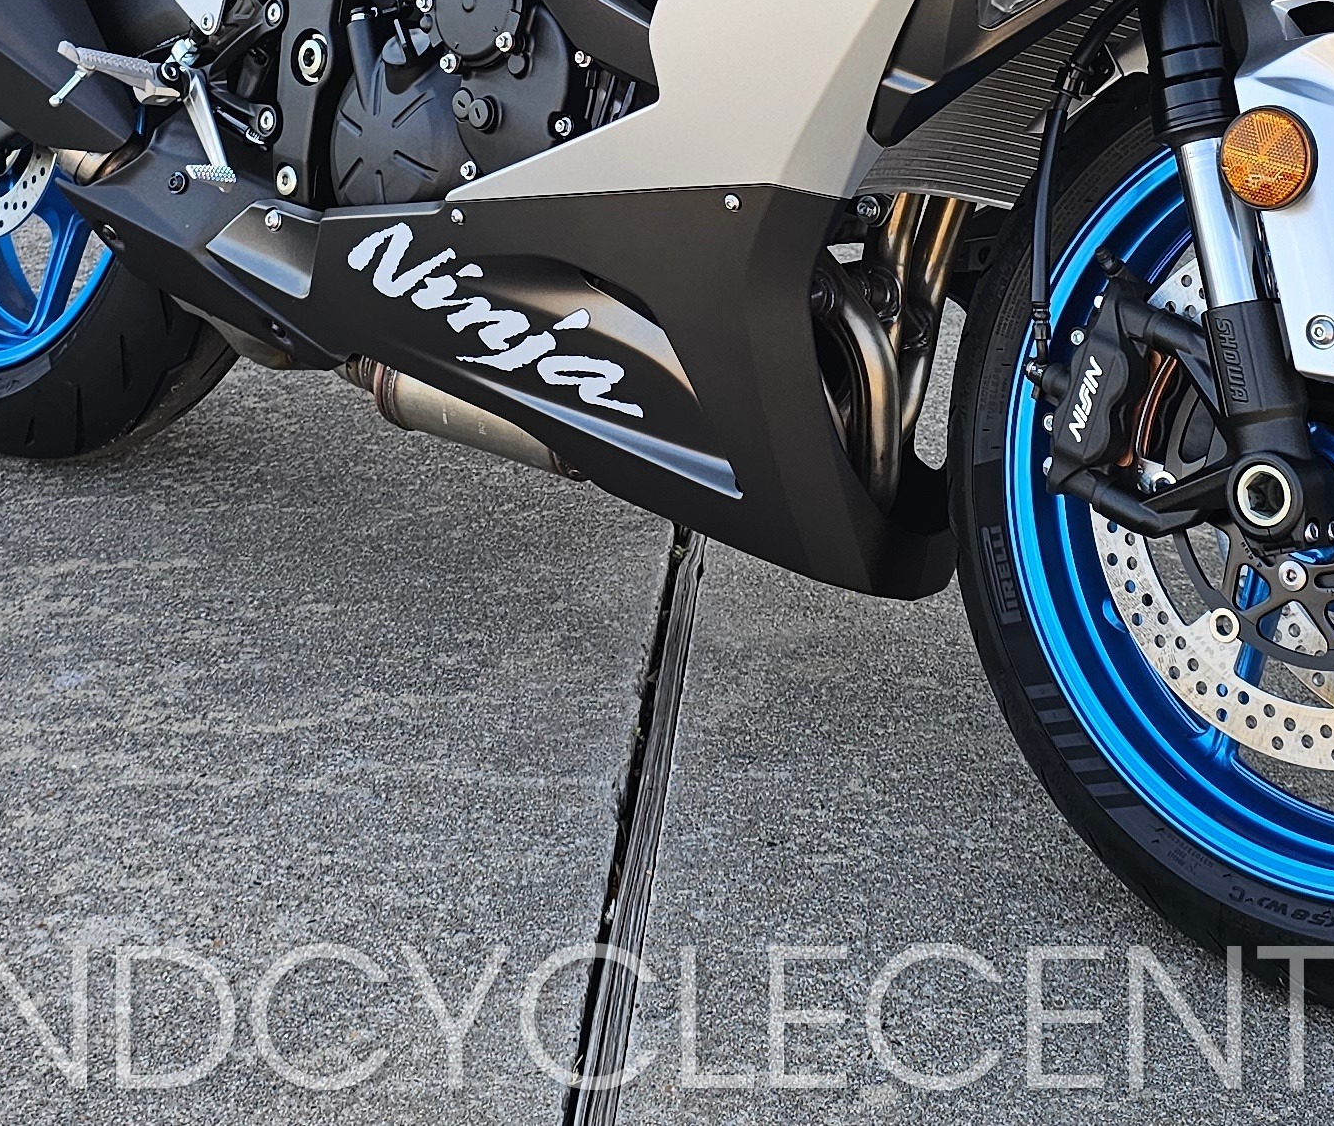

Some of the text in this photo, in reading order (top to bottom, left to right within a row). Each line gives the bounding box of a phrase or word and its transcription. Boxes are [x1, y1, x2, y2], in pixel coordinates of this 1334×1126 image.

[347, 222, 644, 418] Ninja
[1215, 317, 1249, 404] SHOWA
[982, 524, 1022, 624] PIRELLI
